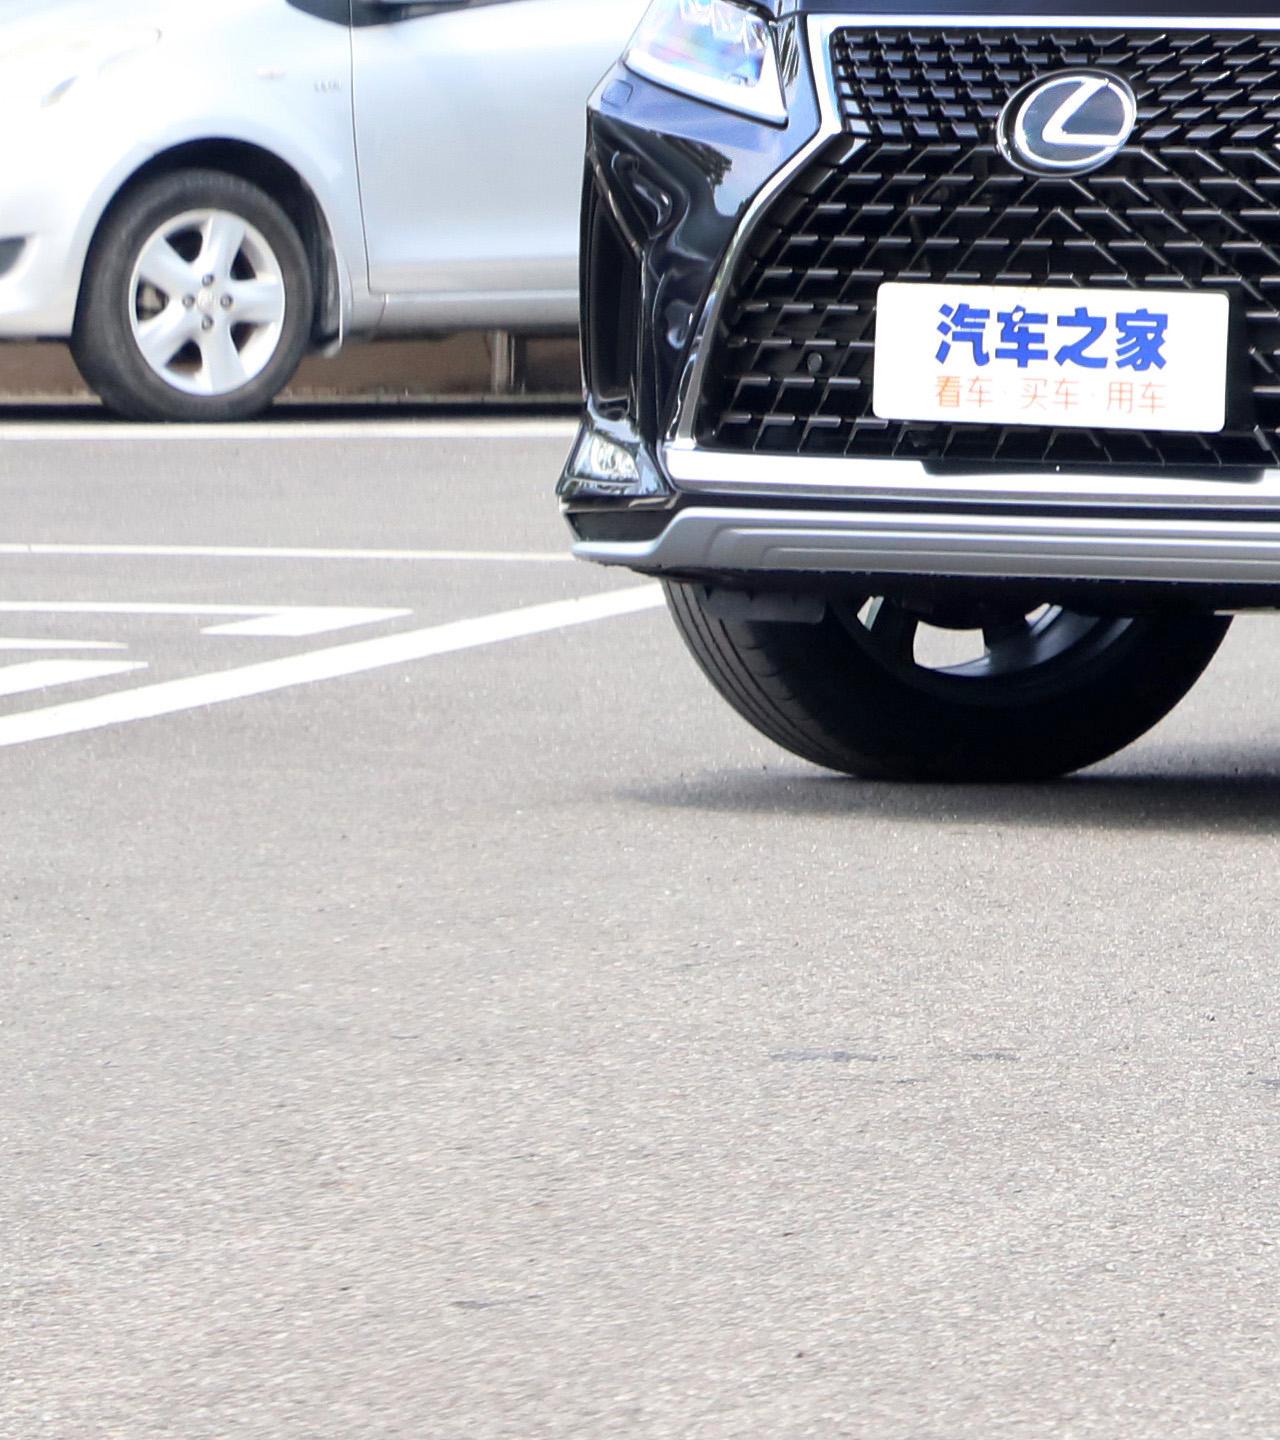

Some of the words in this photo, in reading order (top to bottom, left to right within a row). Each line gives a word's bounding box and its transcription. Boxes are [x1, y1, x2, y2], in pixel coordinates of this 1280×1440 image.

[935, 303, 1168, 371] 汽车之家
[935, 375, 993, 408] 看车
[1019, 377, 1080, 410] 买车
[1106, 380, 1167, 414] 用车
